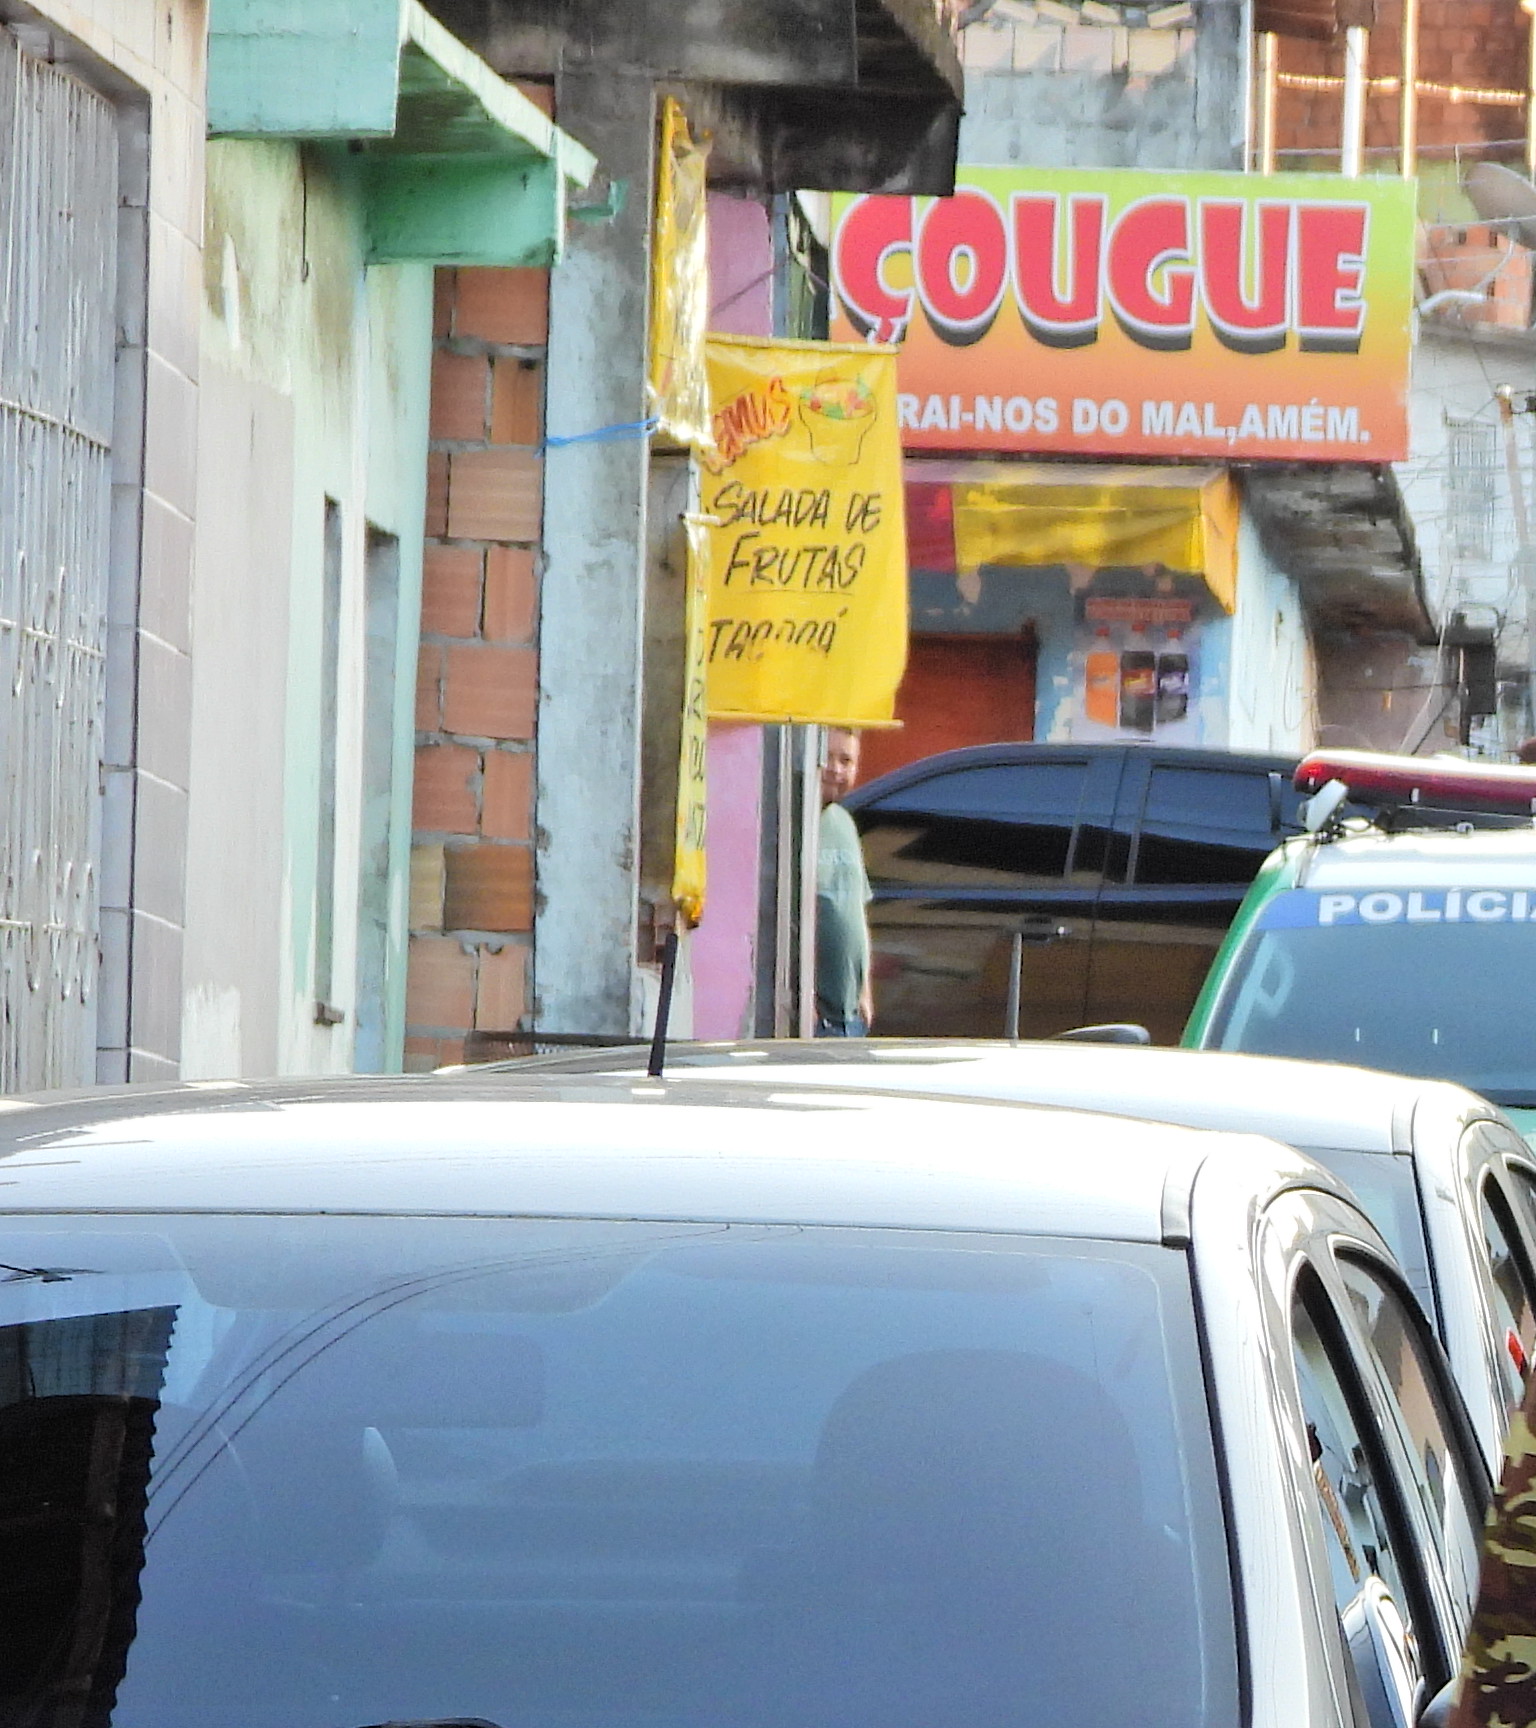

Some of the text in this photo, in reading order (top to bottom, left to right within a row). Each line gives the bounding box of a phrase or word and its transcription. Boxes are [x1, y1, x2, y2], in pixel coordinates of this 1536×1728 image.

[829, 185, 1371, 348] ÇOUGUE
[898, 394, 1059, 432] RAI-NOS
[1072, 398, 1130, 434] DO
[706, 480, 882, 534] SALADA DE
[724, 531, 866, 589] FRUTAS
